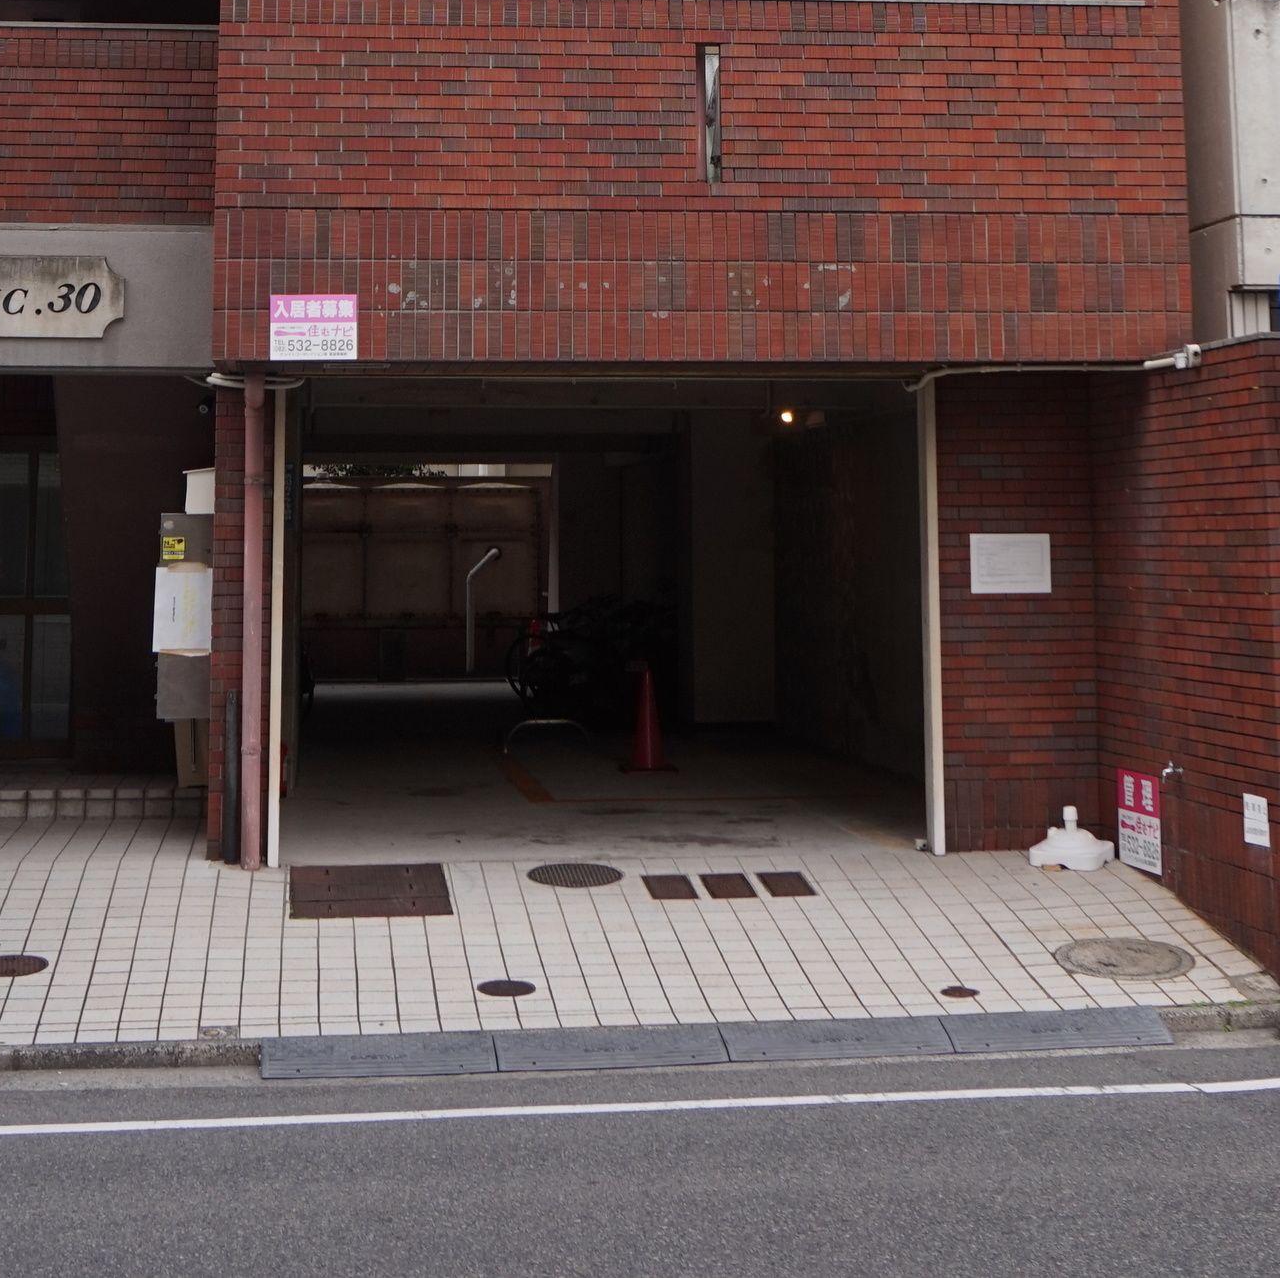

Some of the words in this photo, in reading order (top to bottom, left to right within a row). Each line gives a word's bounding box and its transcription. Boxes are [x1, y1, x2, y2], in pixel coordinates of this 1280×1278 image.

[273, 299, 354, 319] 入居者募集
[287, 338, 354, 352] 532-8826
